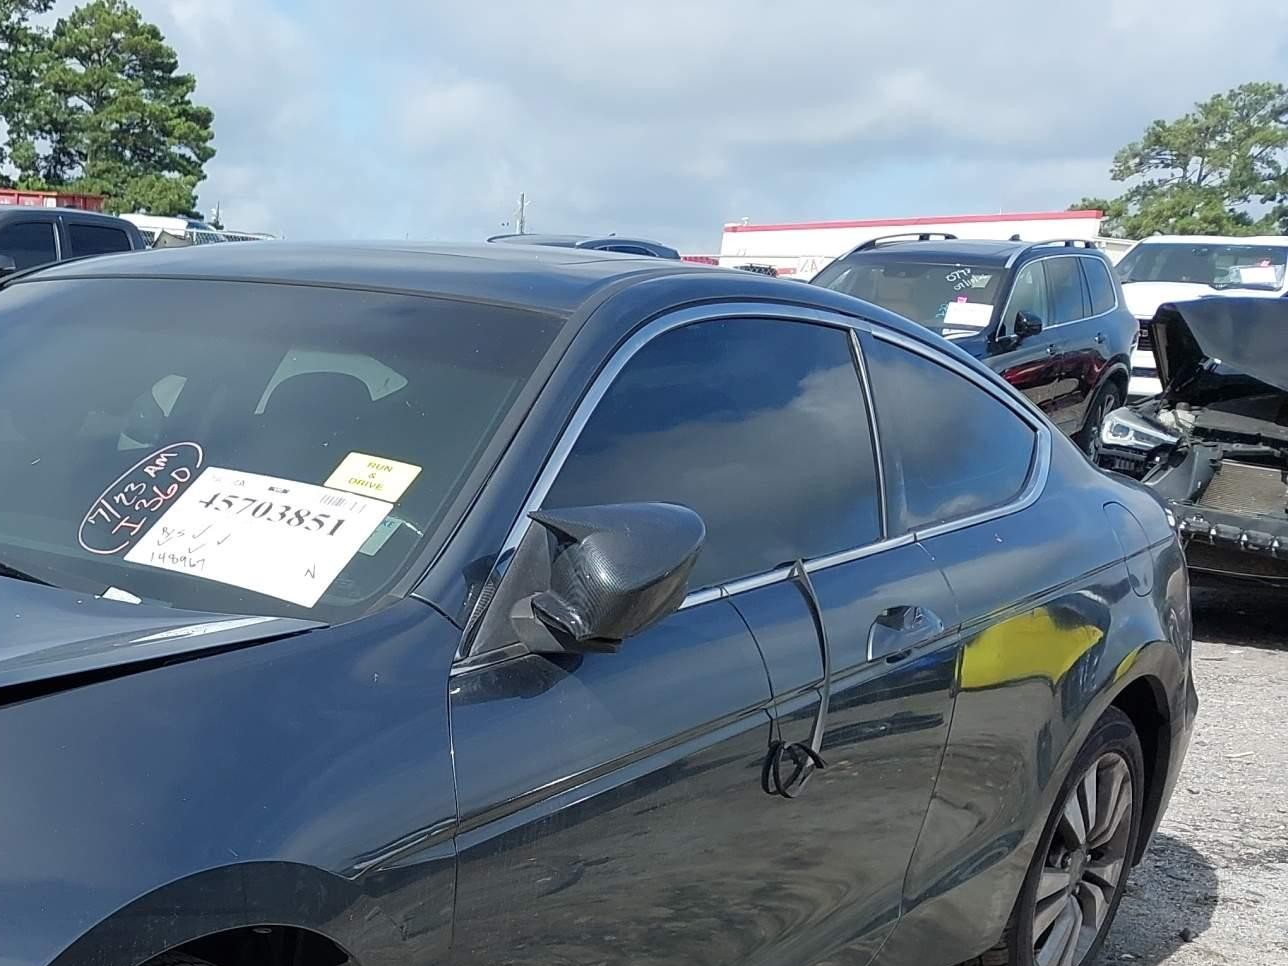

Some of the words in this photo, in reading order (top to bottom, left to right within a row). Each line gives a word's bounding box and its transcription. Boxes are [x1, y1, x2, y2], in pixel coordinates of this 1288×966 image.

[367, 461, 393, 473] RUN
[368, 472, 377, 480] &
[87, 482, 147, 525] 7/23
[143, 452, 179, 478] AM
[348, 477, 384, 491] DRIVE
[199, 492, 345, 536] 45703851
